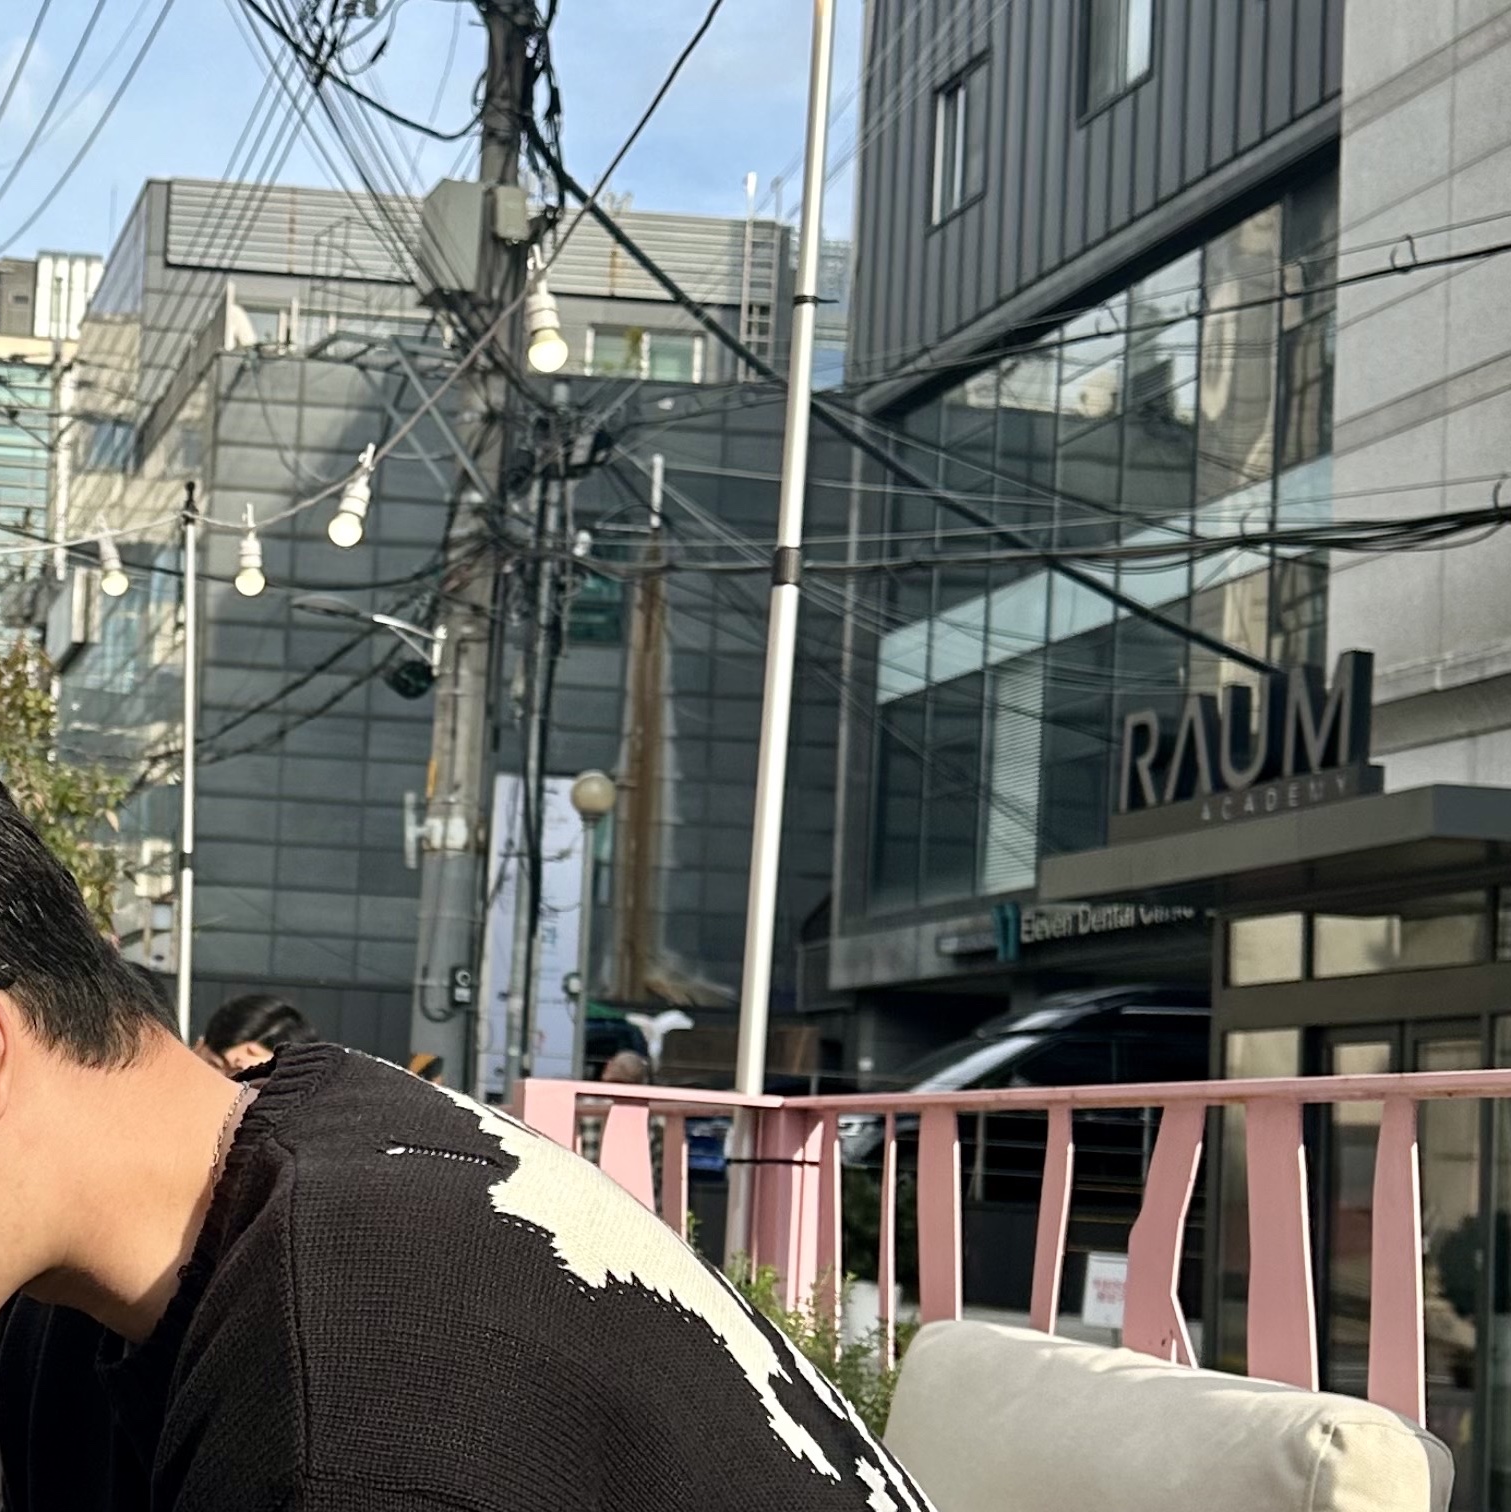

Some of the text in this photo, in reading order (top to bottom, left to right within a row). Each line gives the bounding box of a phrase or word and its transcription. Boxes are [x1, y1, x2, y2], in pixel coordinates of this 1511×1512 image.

[1119, 650, 1366, 815] RAUM
[1200, 775, 1346, 822] ACADEMY
[1078, 903, 1135, 934] Dental
